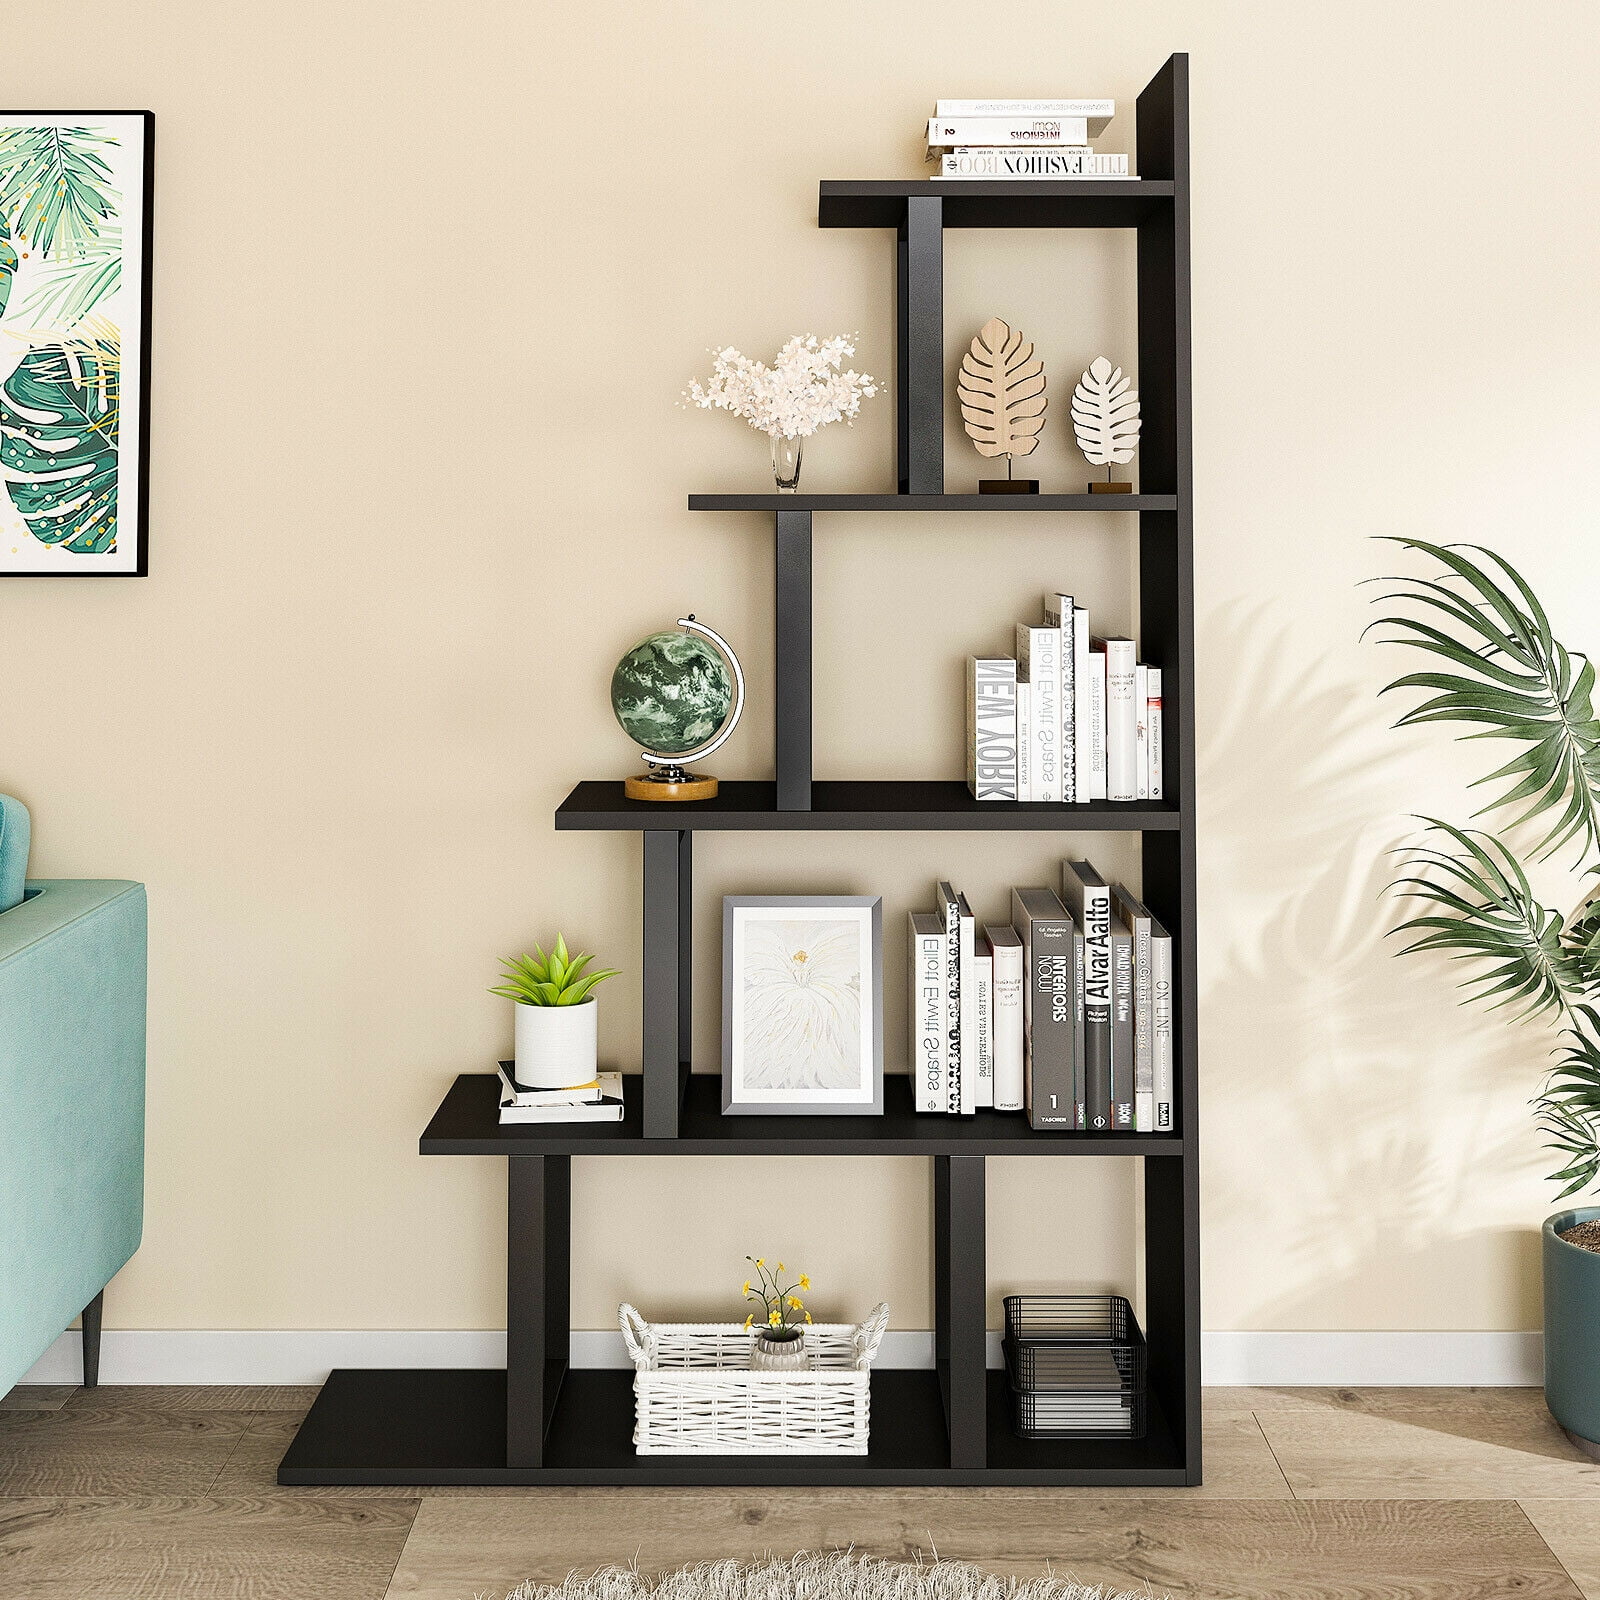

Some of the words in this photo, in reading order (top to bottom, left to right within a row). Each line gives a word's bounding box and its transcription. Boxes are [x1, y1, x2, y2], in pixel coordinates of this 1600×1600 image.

[1010, 131, 1061, 140] INTERIORS
[1004, 156, 1082, 174] FASHION
[1088, 156, 1126, 174] THE
[1086, 897, 1109, 950] Aalto
[1139, 930, 1150, 965] Picasso
[1038, 955, 1052, 993] NOW!
[1086, 948, 1109, 999] Alvar
[1138, 967, 1150, 1004] Guitars
[1052, 955, 1067, 1023] INTERIORS
[1156, 980, 1169, 1000] ON
[1156, 1006, 1169, 1038] LINE
[1049, 1094, 1057, 1109] 1
[1118, 1103, 1131, 1124] TASCHEN
[1159, 1103, 1168, 1126] MoMA
